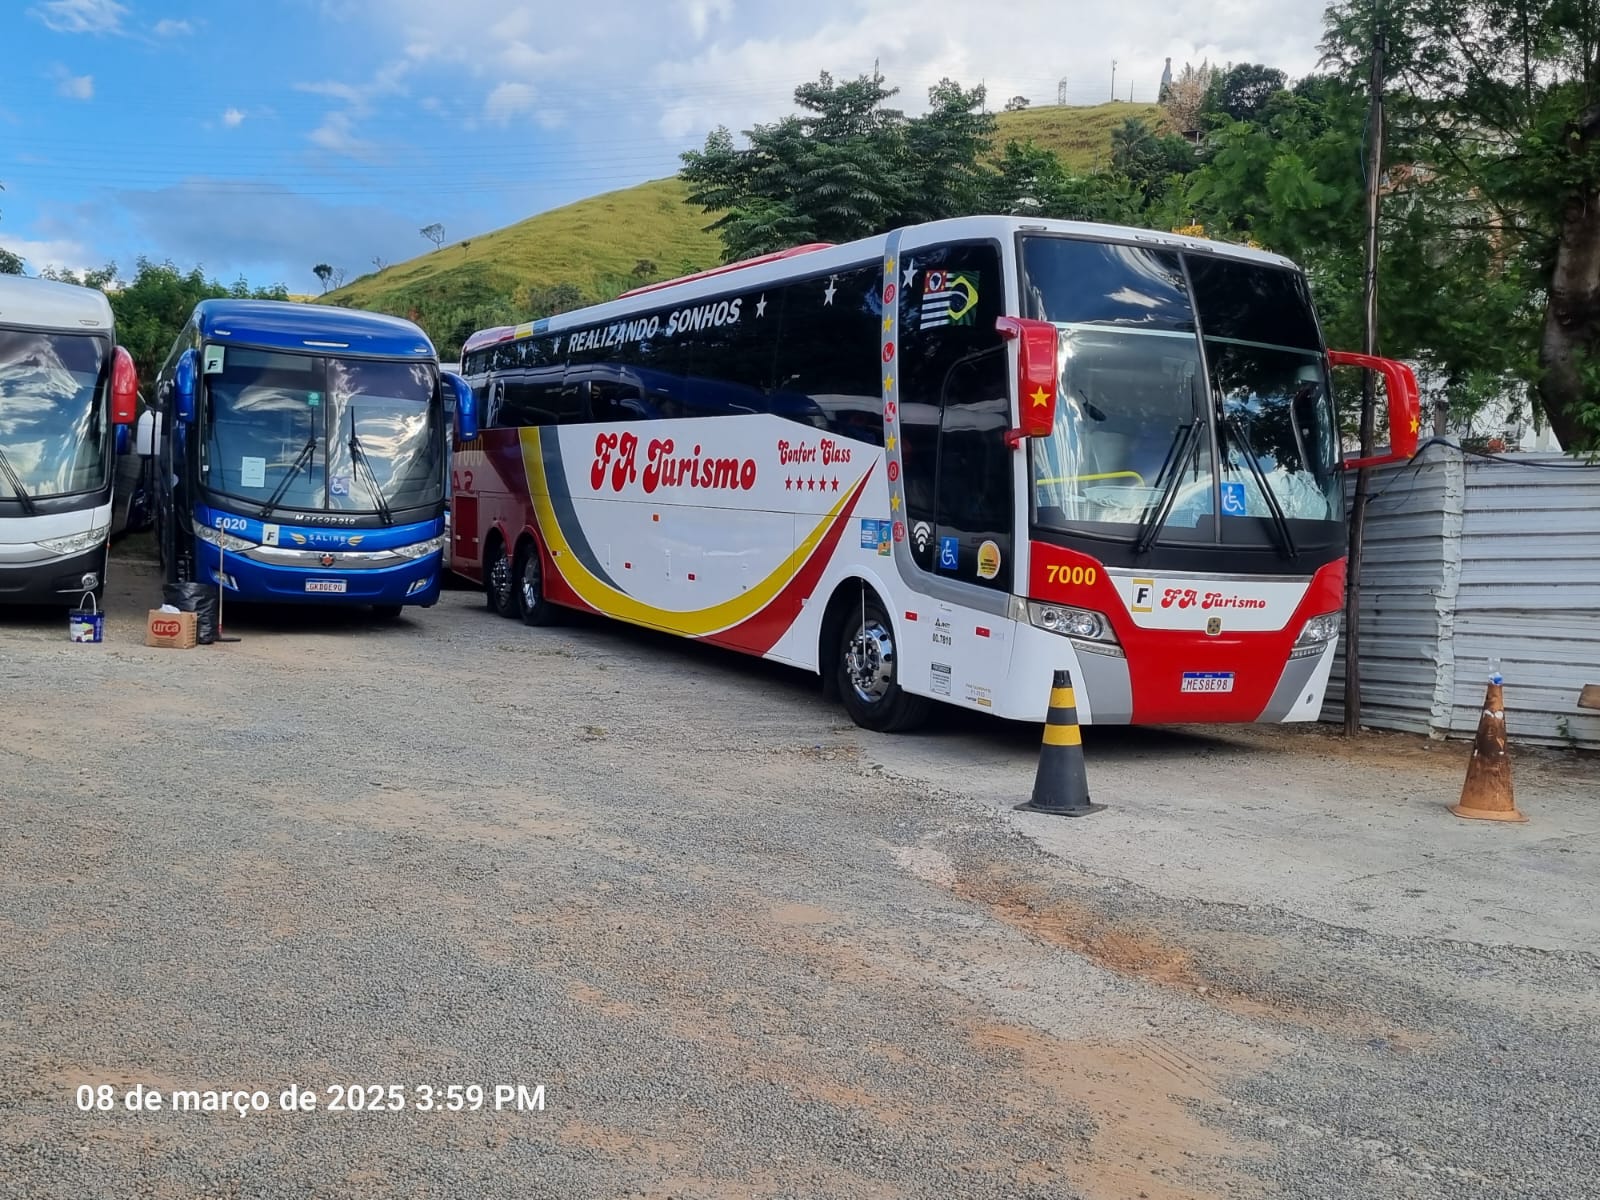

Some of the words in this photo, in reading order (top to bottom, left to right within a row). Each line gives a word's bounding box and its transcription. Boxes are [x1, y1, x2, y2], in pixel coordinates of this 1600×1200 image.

[567, 315, 660, 353] REALIZANDO
[666, 298, 743, 337] SONHOS
[207, 360, 218, 370] F
[777, 439, 817, 465] Confort
[820, 438, 852, 466] Class
[590, 431, 638, 493] FA
[642, 438, 757, 494] Turismo
[215, 517, 247, 530] 5020
[266, 531, 275, 541] F
[1046, 565, 1096, 585] 7000
[1136, 587, 1149, 604] F
[1161, 588, 1198, 609] FA
[1201, 592, 1266, 610] Turismo
[153, 623, 179, 633] urca
